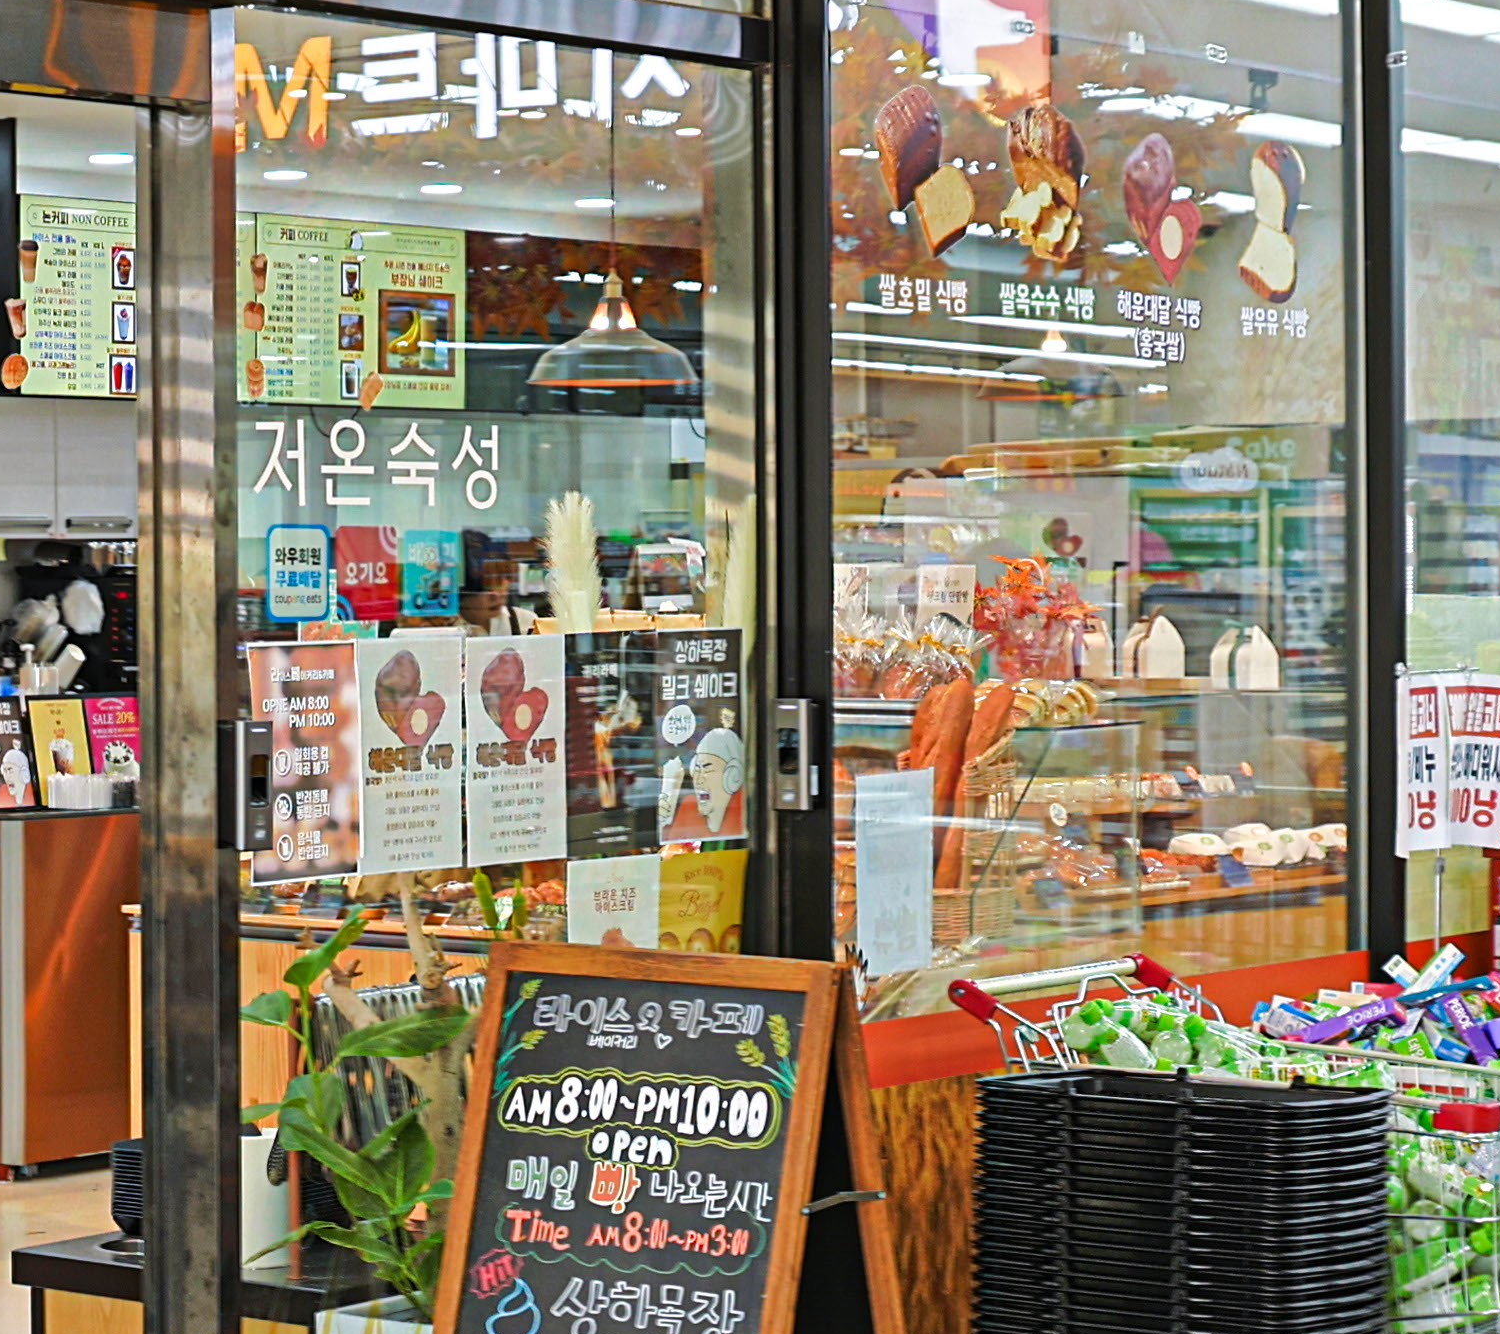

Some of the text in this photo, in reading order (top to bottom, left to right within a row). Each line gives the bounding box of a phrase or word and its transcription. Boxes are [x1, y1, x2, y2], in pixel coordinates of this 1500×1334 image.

[93, 215, 129, 227] COFFEE
[297, 231, 329, 243] COFFEE
[878, 273, 968, 314] 쌀호밀 식빵
[999, 281, 1095, 321] 쌀옥수수 식빵
[1116, 289, 1202, 331] 해운대달 식빵
[1240, 306, 1310, 339] 쌀우유 식빵
[1133, 326, 1186, 364] (홍국쌀)
[252, 417, 500, 511] 저온숙성
[274, 547, 322, 566] 와우회원
[275, 570, 322, 589] 무료배달
[344, 561, 389, 585] 요기요
[306, 593, 322, 604] eats
[674, 638, 728, 664] 상하목장
[661, 672, 738, 701] 밀크 쉐이크
[289, 696, 307, 712] AM
[308, 695, 329, 710] 8:00
[92, 711, 136, 725] SALE 20%
[288, 712, 335, 729] PM 10:00
[1446, 996, 1474, 1030] PERIOE
[587, 1033, 639, 1050] 베이커리
[506, 1155, 579, 1211] 매일
[505, 1208, 571, 1251] Time
